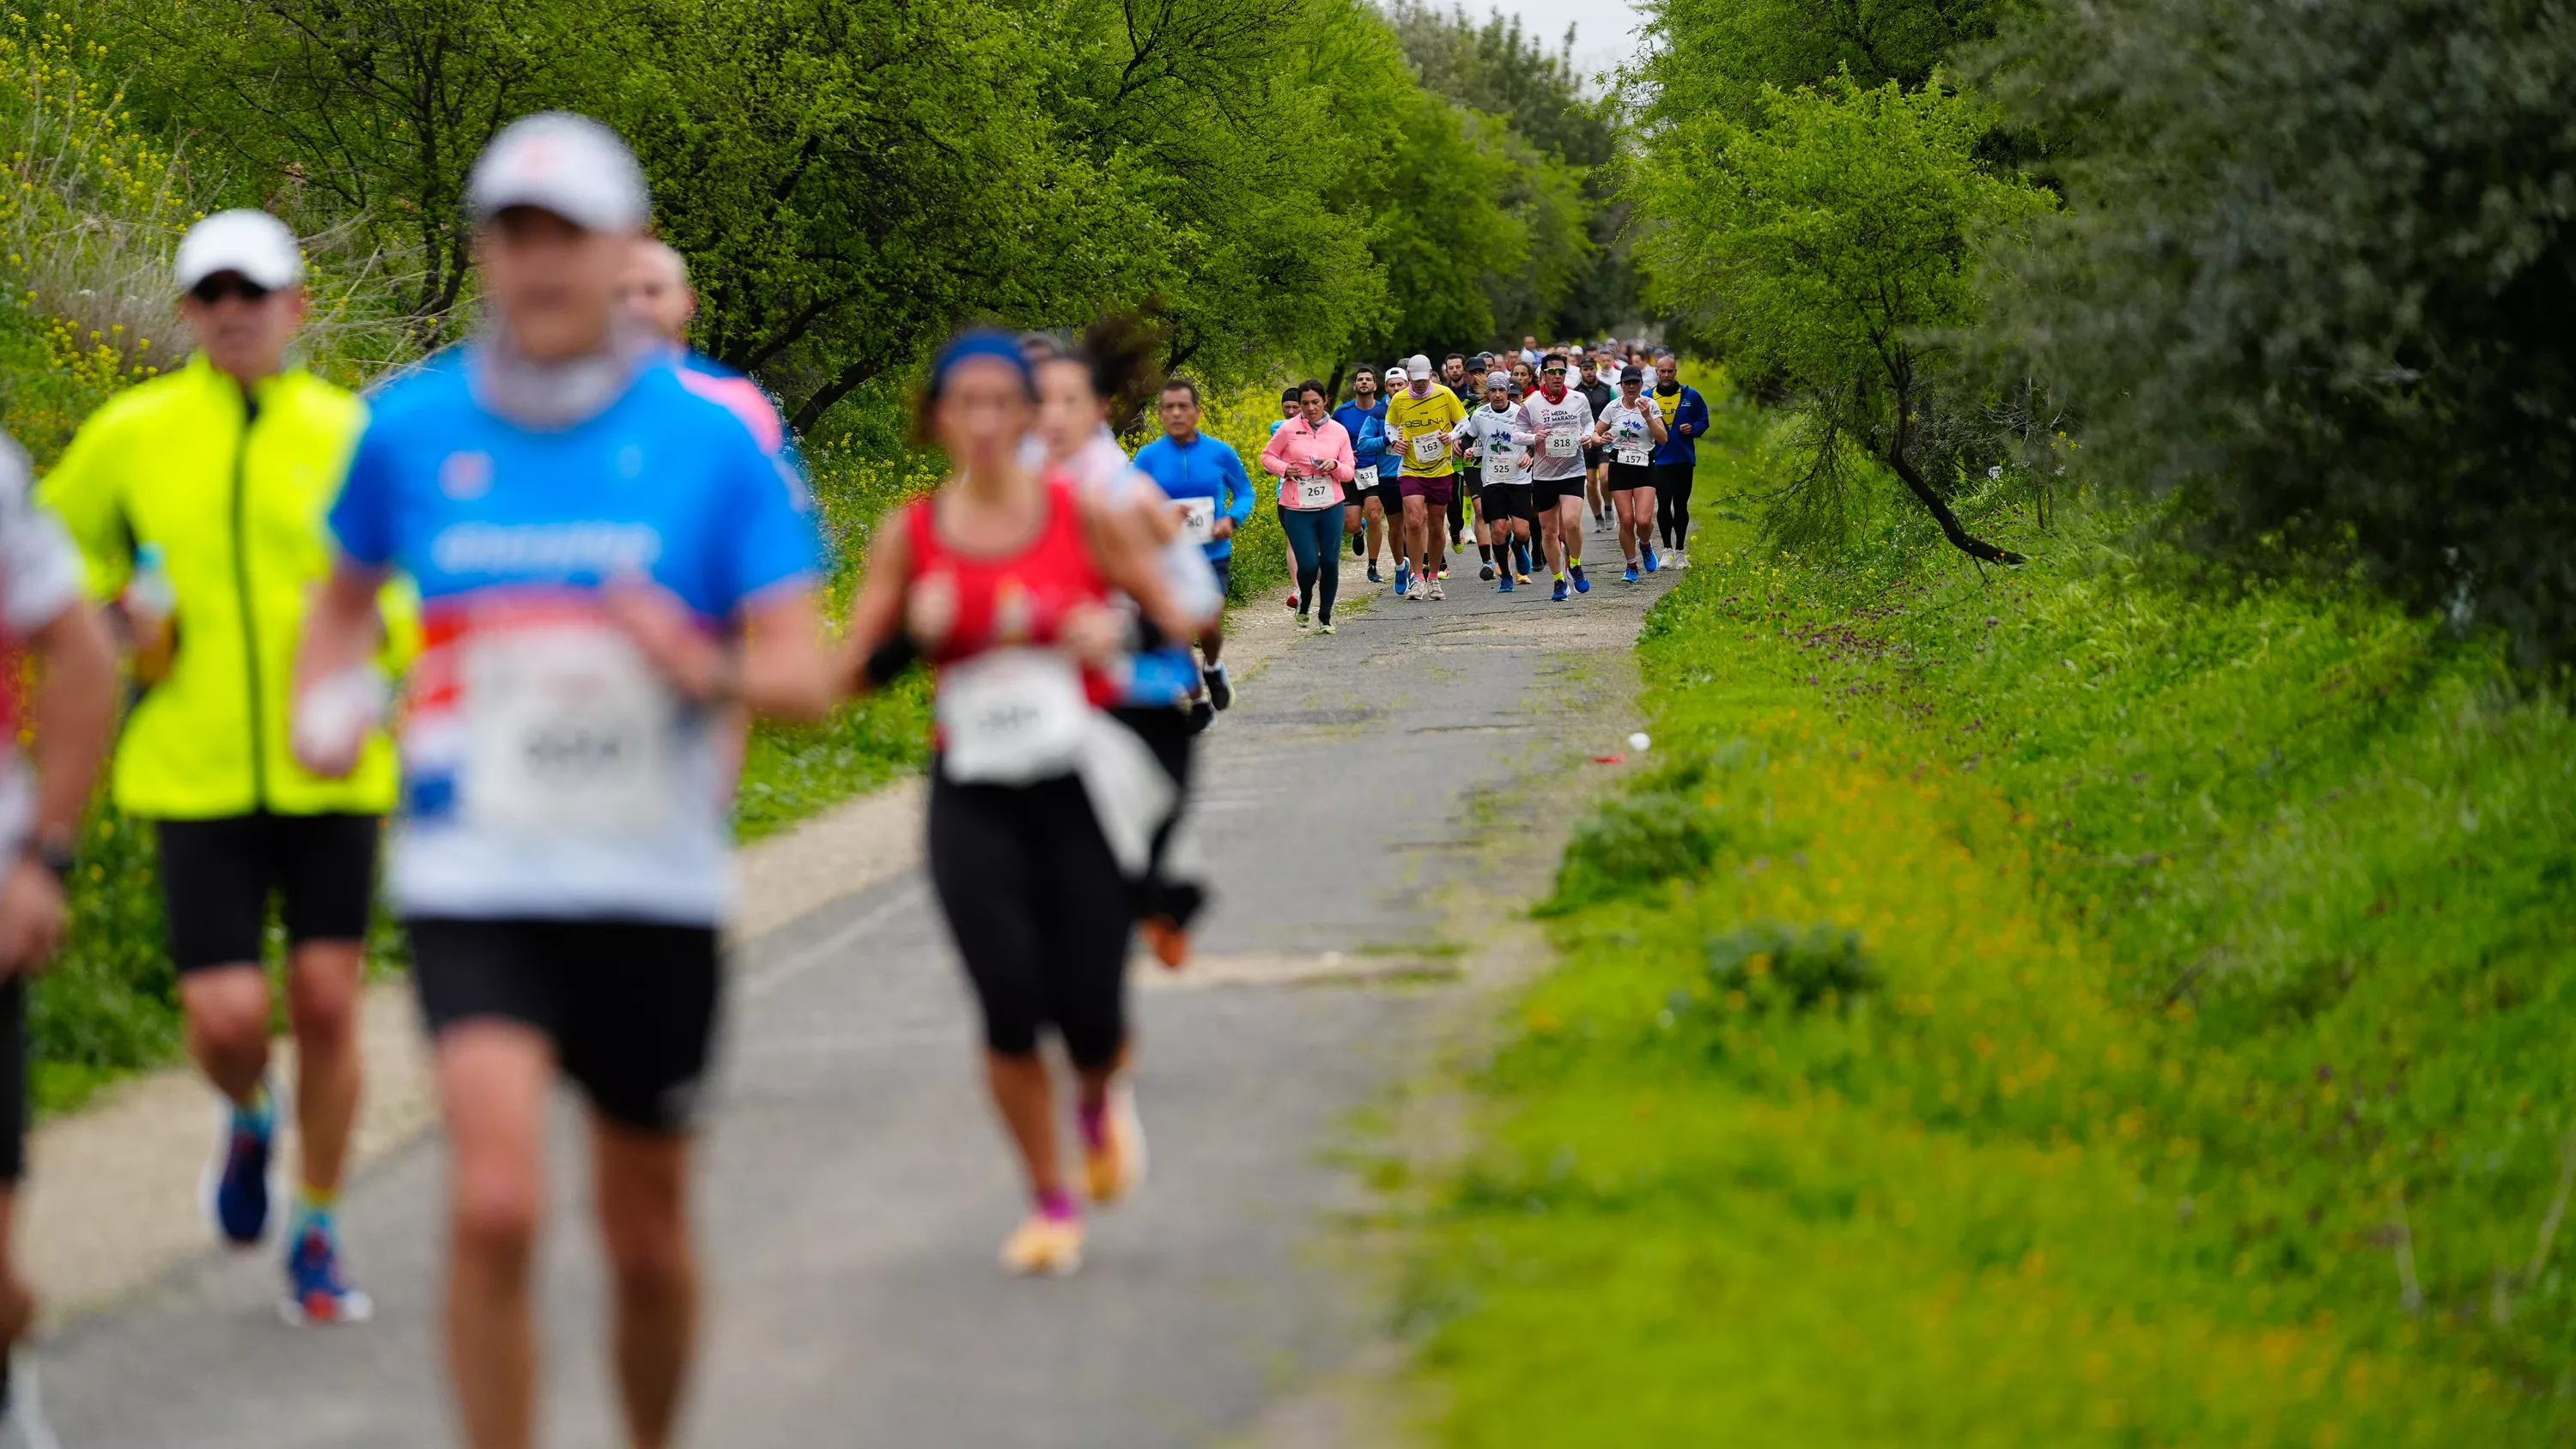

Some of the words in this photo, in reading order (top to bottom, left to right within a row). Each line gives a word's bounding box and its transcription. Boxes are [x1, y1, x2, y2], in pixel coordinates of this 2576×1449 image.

[1422, 441, 1438, 453] 163
[1474, 440, 1484, 450] 10
[1554, 439, 1571, 447] 818
[1625, 455, 1641, 464] 157
[1360, 471, 1374, 480] 431
[1307, 486, 1326, 496] 267
